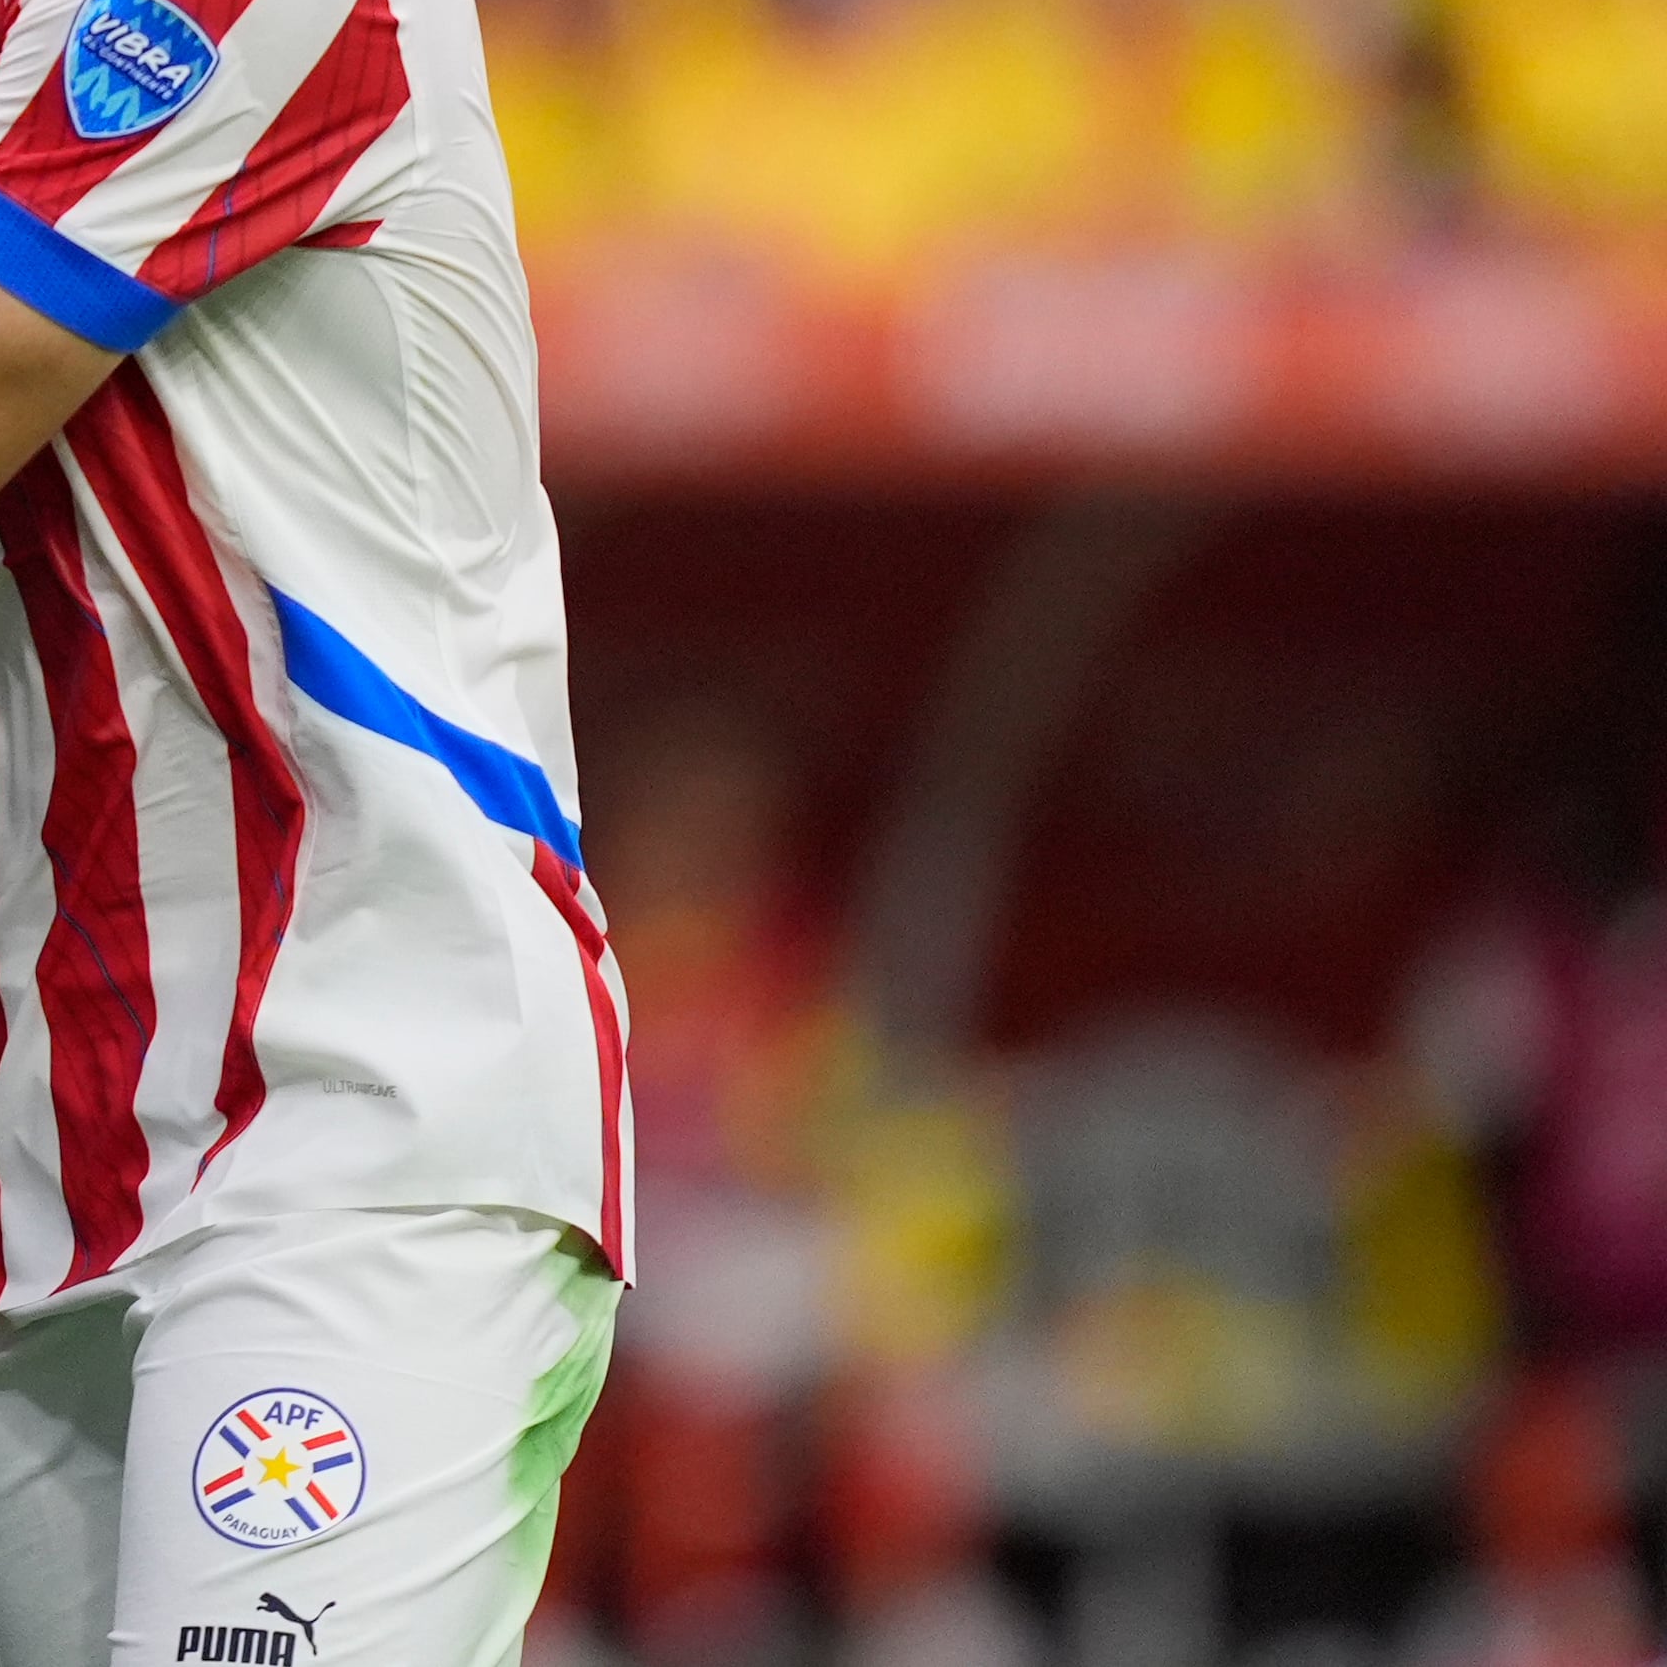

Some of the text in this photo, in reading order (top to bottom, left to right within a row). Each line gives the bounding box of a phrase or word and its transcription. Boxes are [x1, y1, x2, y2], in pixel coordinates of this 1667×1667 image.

[90, 12, 191, 90] VIBRA
[262, 1400, 324, 1431] APF
[221, 1512, 300, 1541] PARAGUAY
[176, 1625, 297, 1667] PUMA
